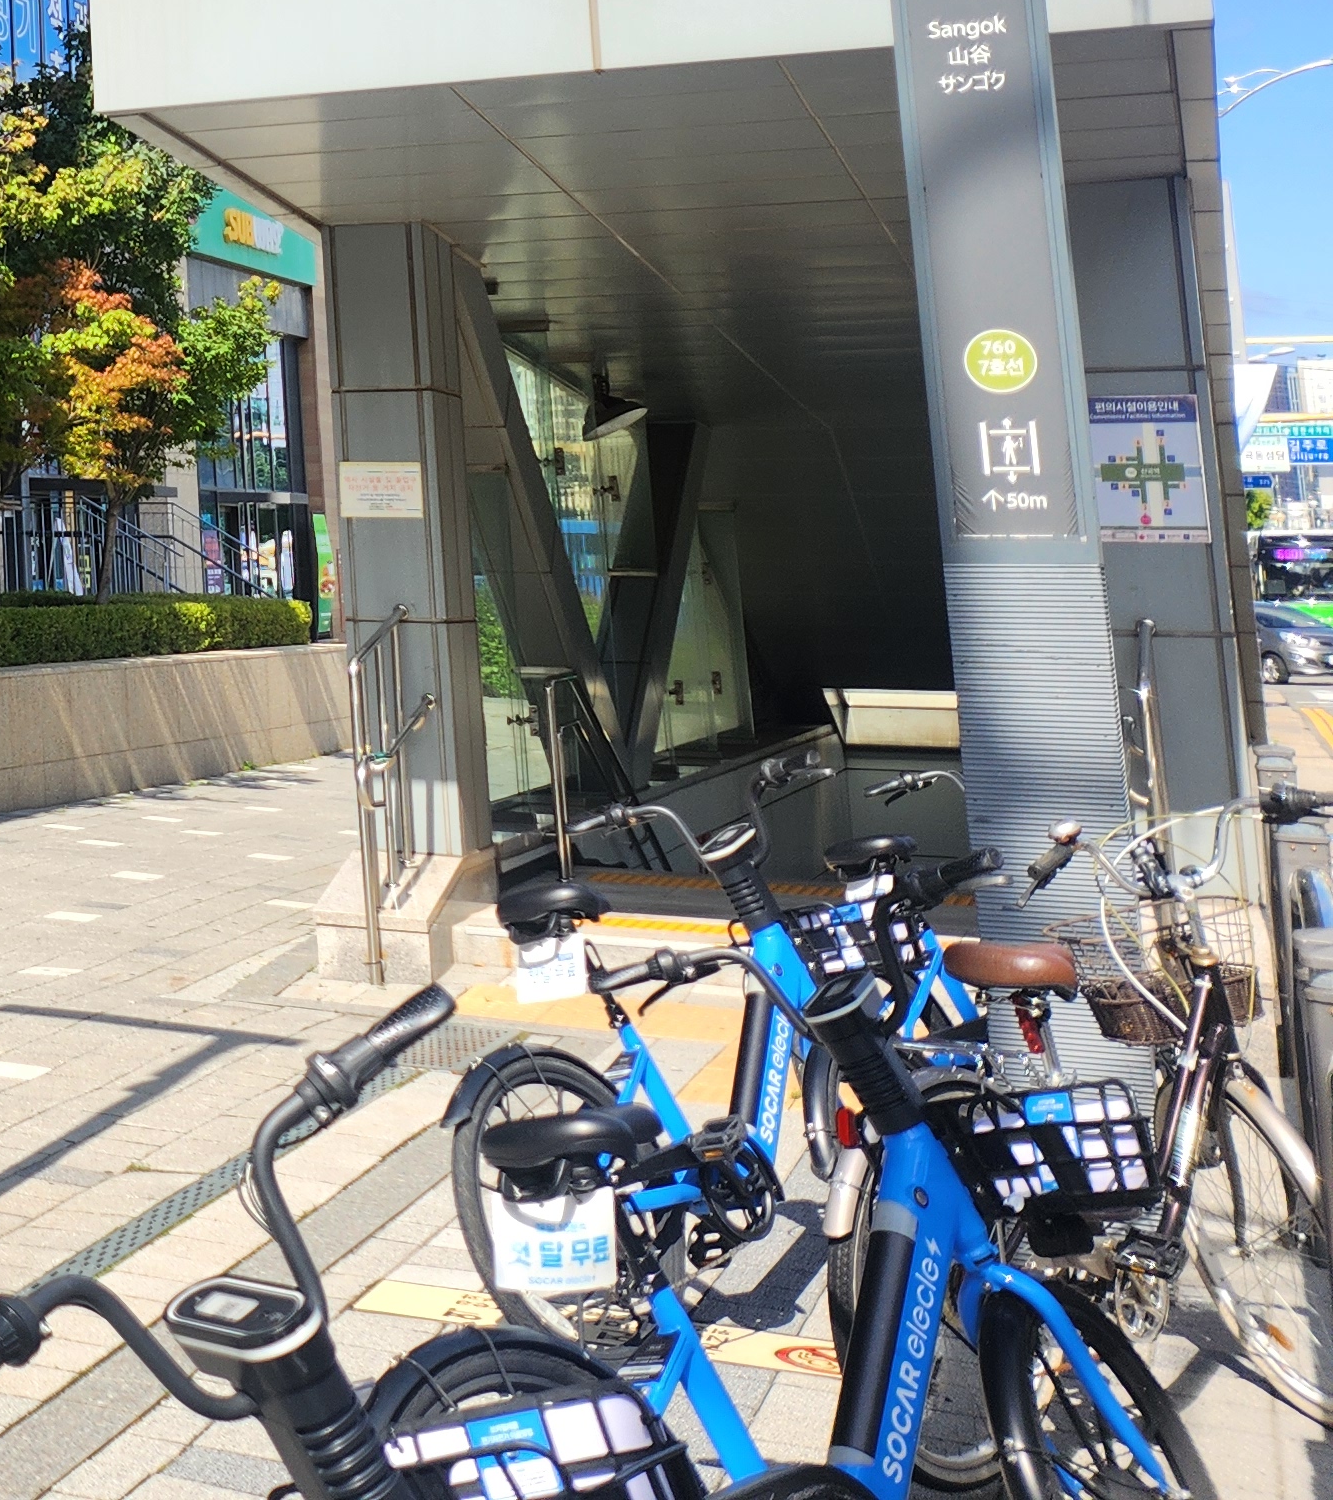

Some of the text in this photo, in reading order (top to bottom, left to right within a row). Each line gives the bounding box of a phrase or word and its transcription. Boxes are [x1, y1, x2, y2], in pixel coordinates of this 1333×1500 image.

[928, 16, 1007, 41] Sangok
[948, 44, 991, 66] 山谷
[938, 70, 1006, 95] サンゴク
[980, 339, 1016, 355] 760
[978, 357, 1025, 377] 7호선
[1007, 493, 1048, 511] 50m
[760, 1014, 791, 1145] SOCAR elecl
[539, 1241, 563, 1268] 달
[571, 1235, 610, 1267] 무료
[528, 1276, 563, 1285] SOCAR
[883, 1257, 940, 1484] SOCAR elecle
